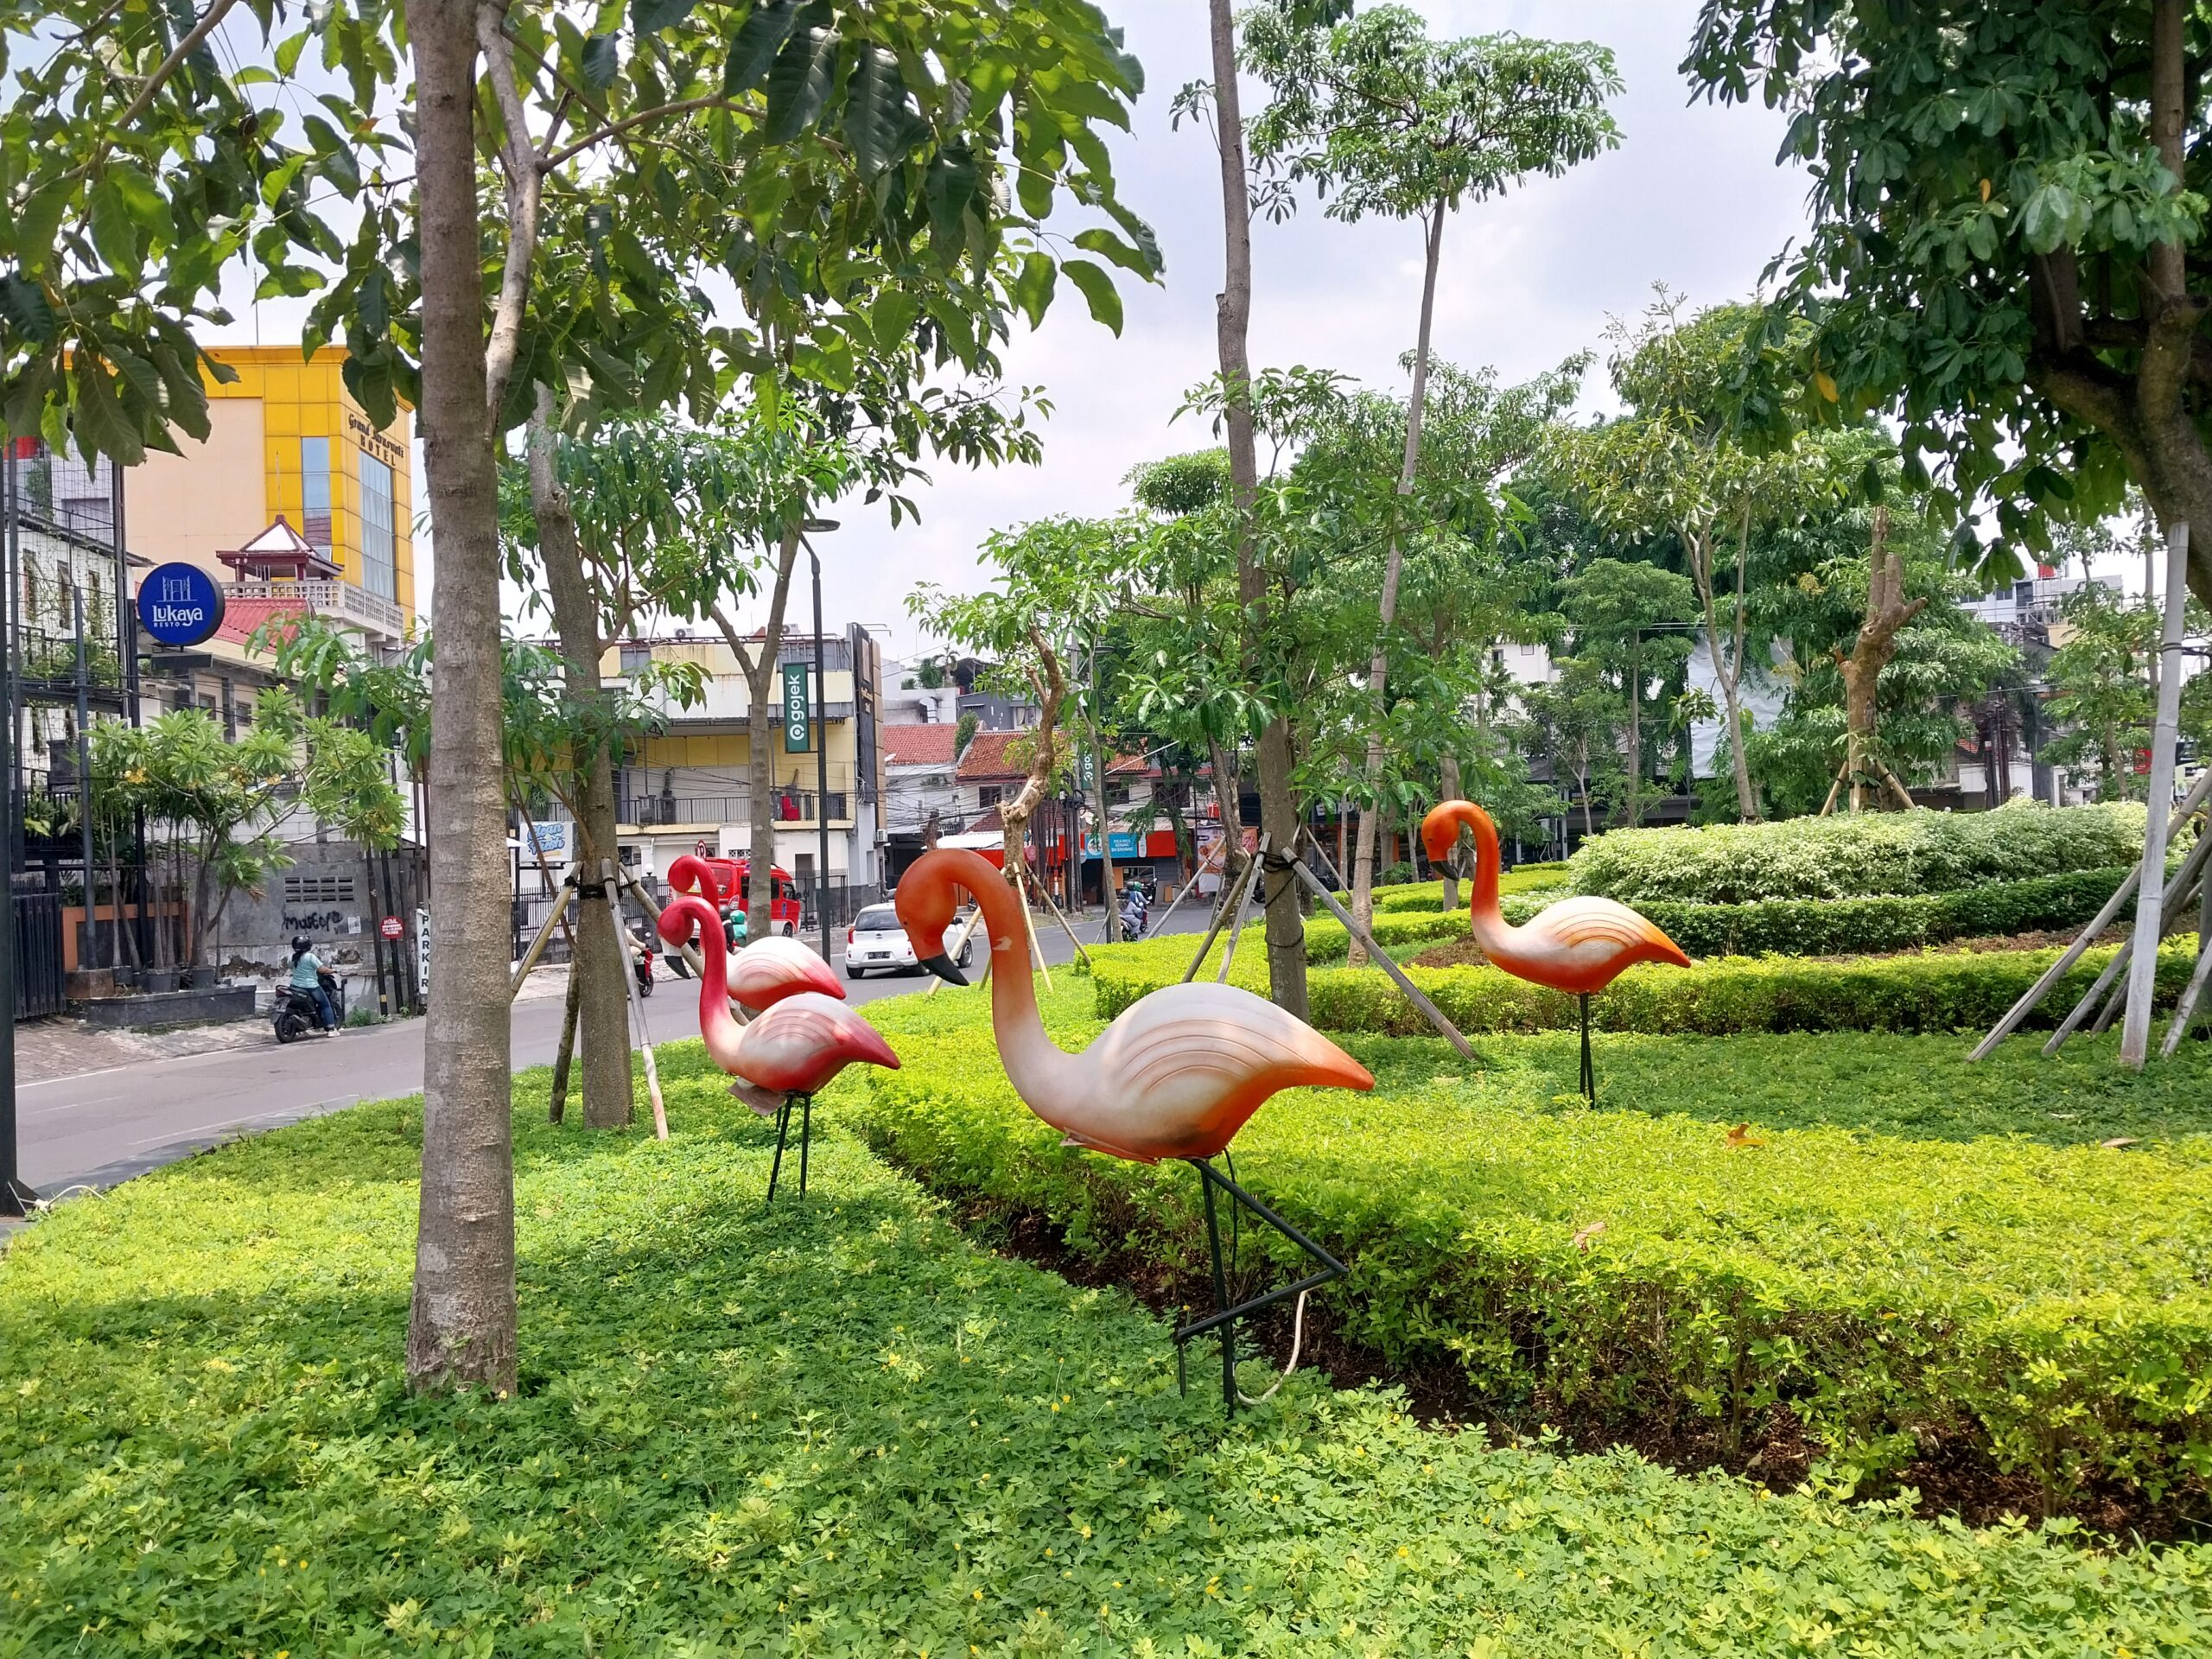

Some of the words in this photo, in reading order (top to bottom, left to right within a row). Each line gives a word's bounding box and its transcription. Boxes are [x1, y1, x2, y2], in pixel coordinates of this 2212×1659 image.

[360, 434, 396, 467] HOTEL
[152, 605, 203, 626] Lukaya
[788, 674, 804, 721] gojek
[421, 915, 430, 988] PARKIR
